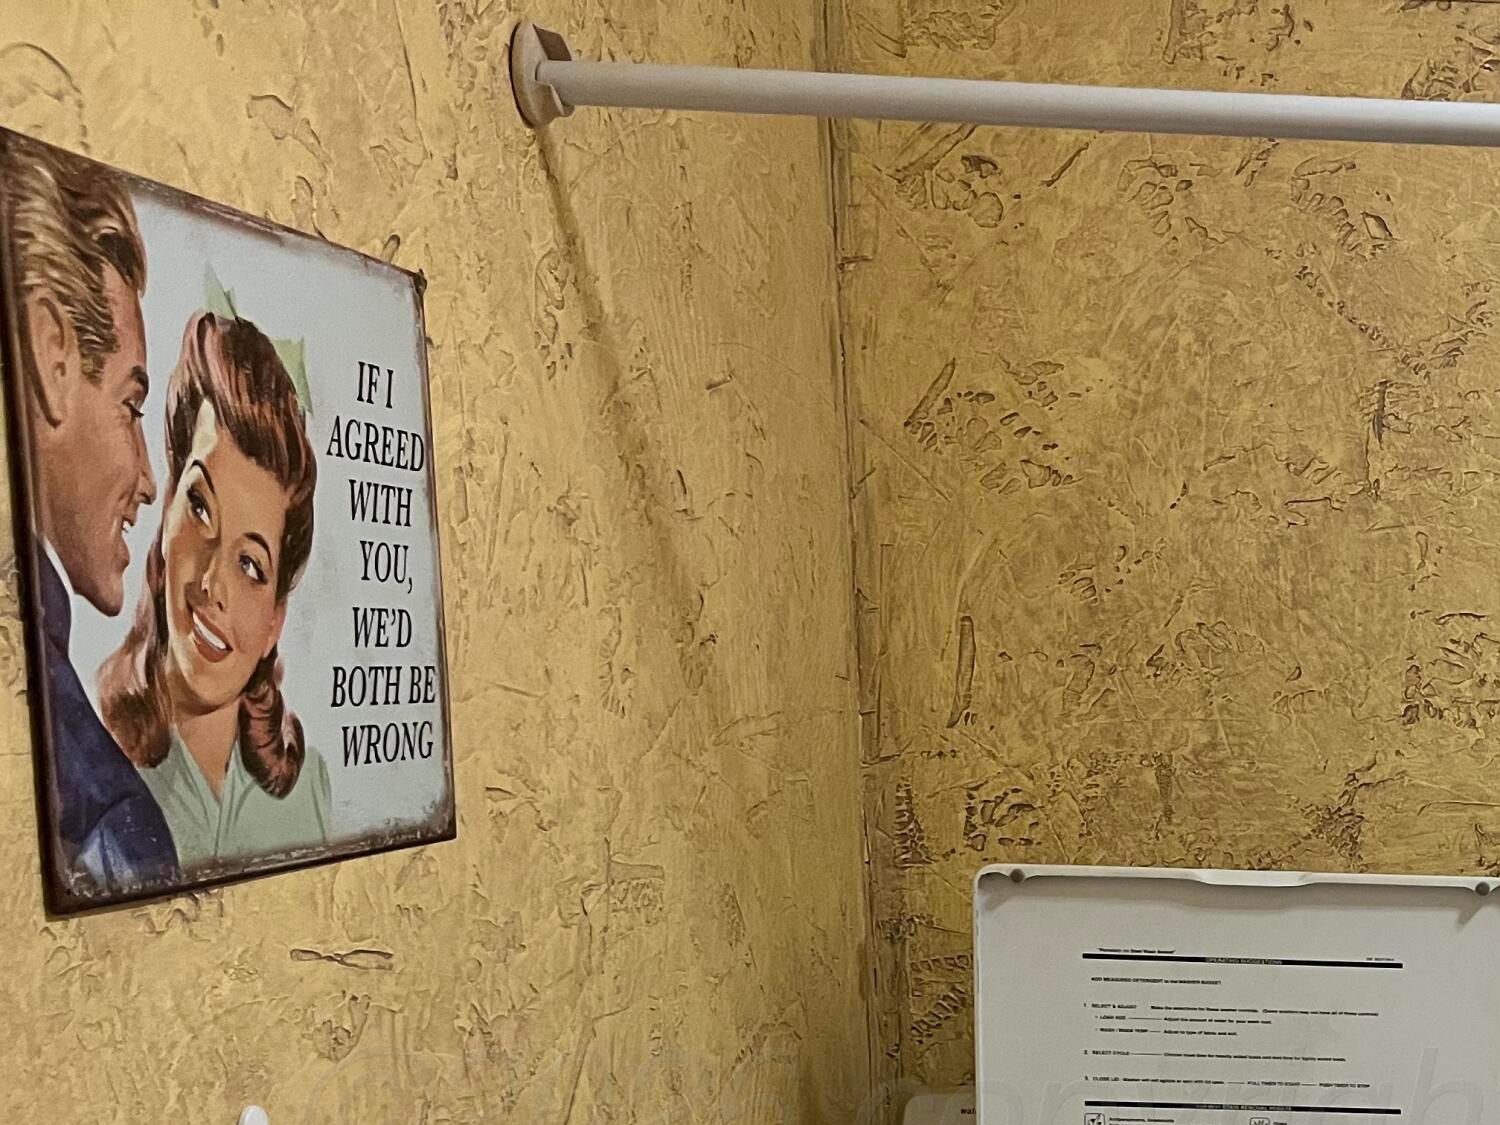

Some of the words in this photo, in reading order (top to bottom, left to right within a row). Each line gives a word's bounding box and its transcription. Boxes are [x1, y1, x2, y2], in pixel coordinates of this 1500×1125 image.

[357, 361, 380, 404] IF
[386, 369, 394, 408] I
[326, 415, 424, 472] AGREED
[348, 479, 413, 527] WITH
[359, 540, 413, 593] YOU,
[352, 606, 412, 648] WE'D
[331, 666, 401, 707] BOTH
[408, 665, 436, 704] BE
[342, 721, 434, 767] WRONG
